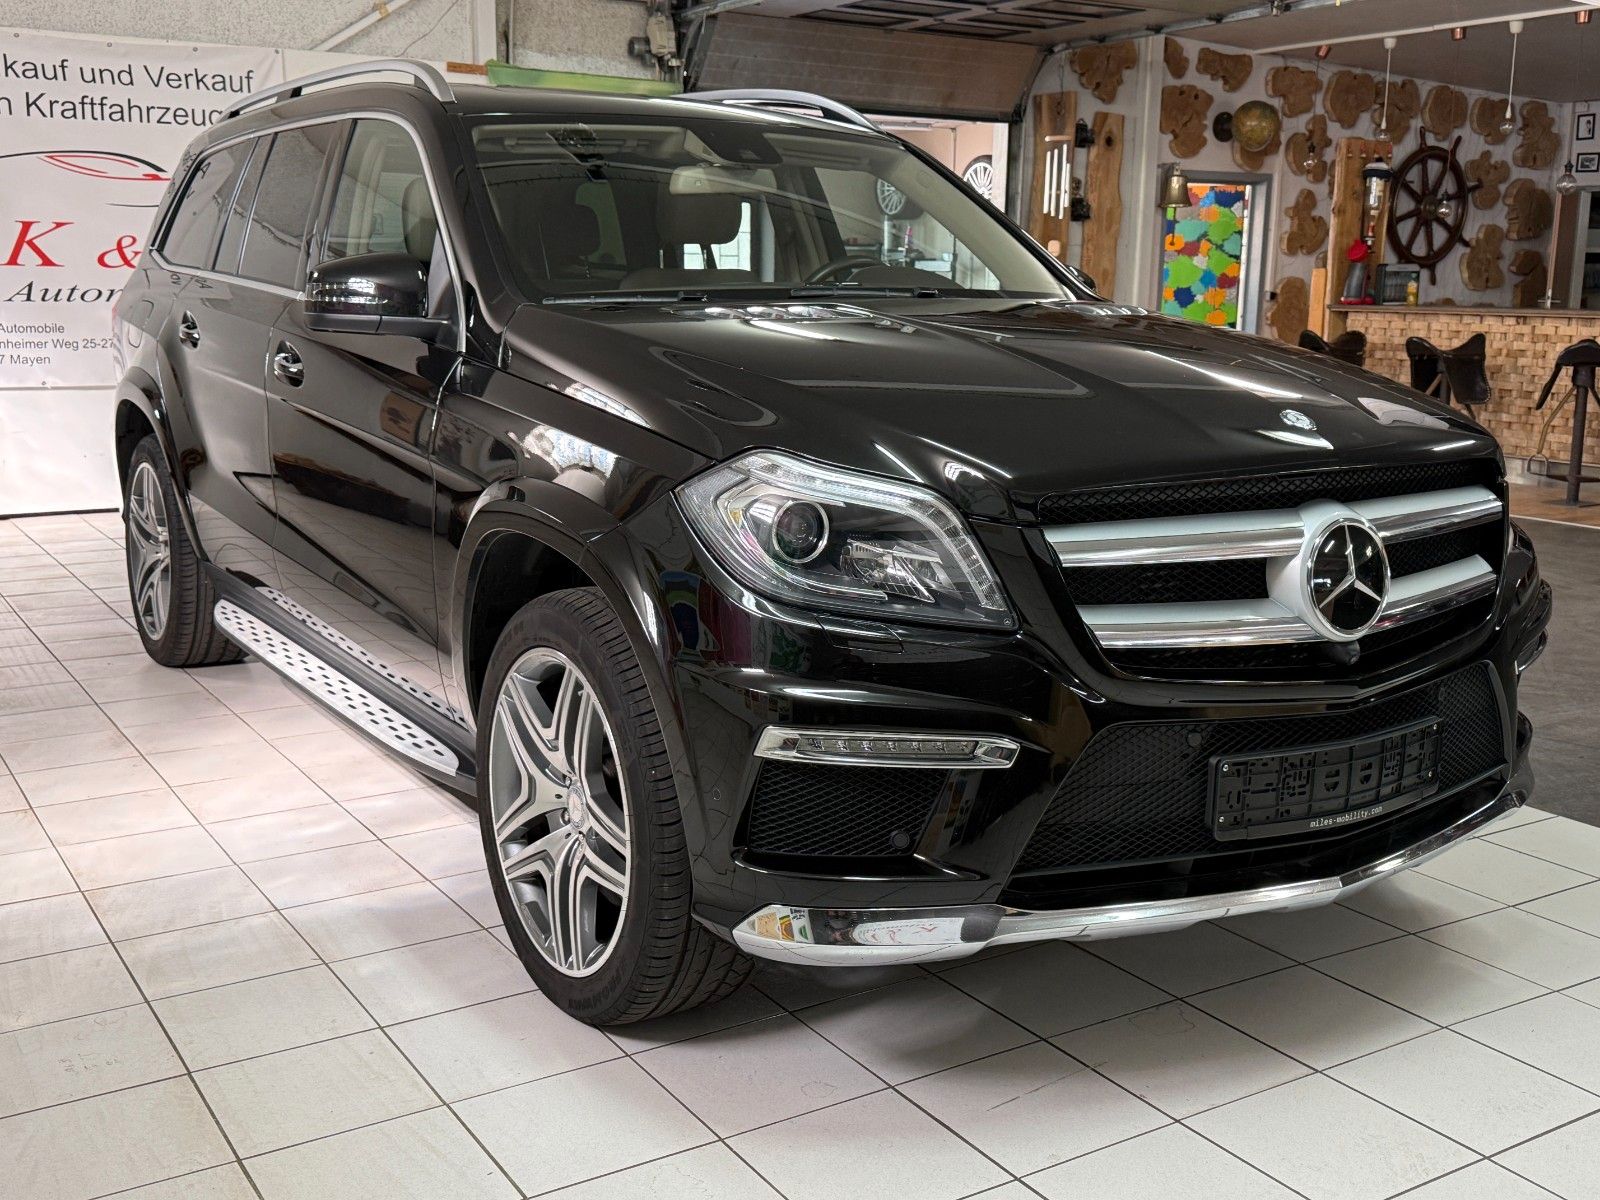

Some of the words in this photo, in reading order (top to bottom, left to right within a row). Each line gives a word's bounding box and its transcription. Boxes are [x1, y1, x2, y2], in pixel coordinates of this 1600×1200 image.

[2, 53, 69, 82] kauf
[79, 64, 135, 87] und
[143, 64, 255, 94] Verkauf
[0, 220, 75, 268] K
[97, 234, 143, 269] &
[0, 338, 49, 349] nheimer
[51, 338, 79, 351] Weg
[82, 338, 114, 349] 25-27
[10, 354, 51, 367] Mayen
[1310, 806, 1383, 828] miles-mobility.com
